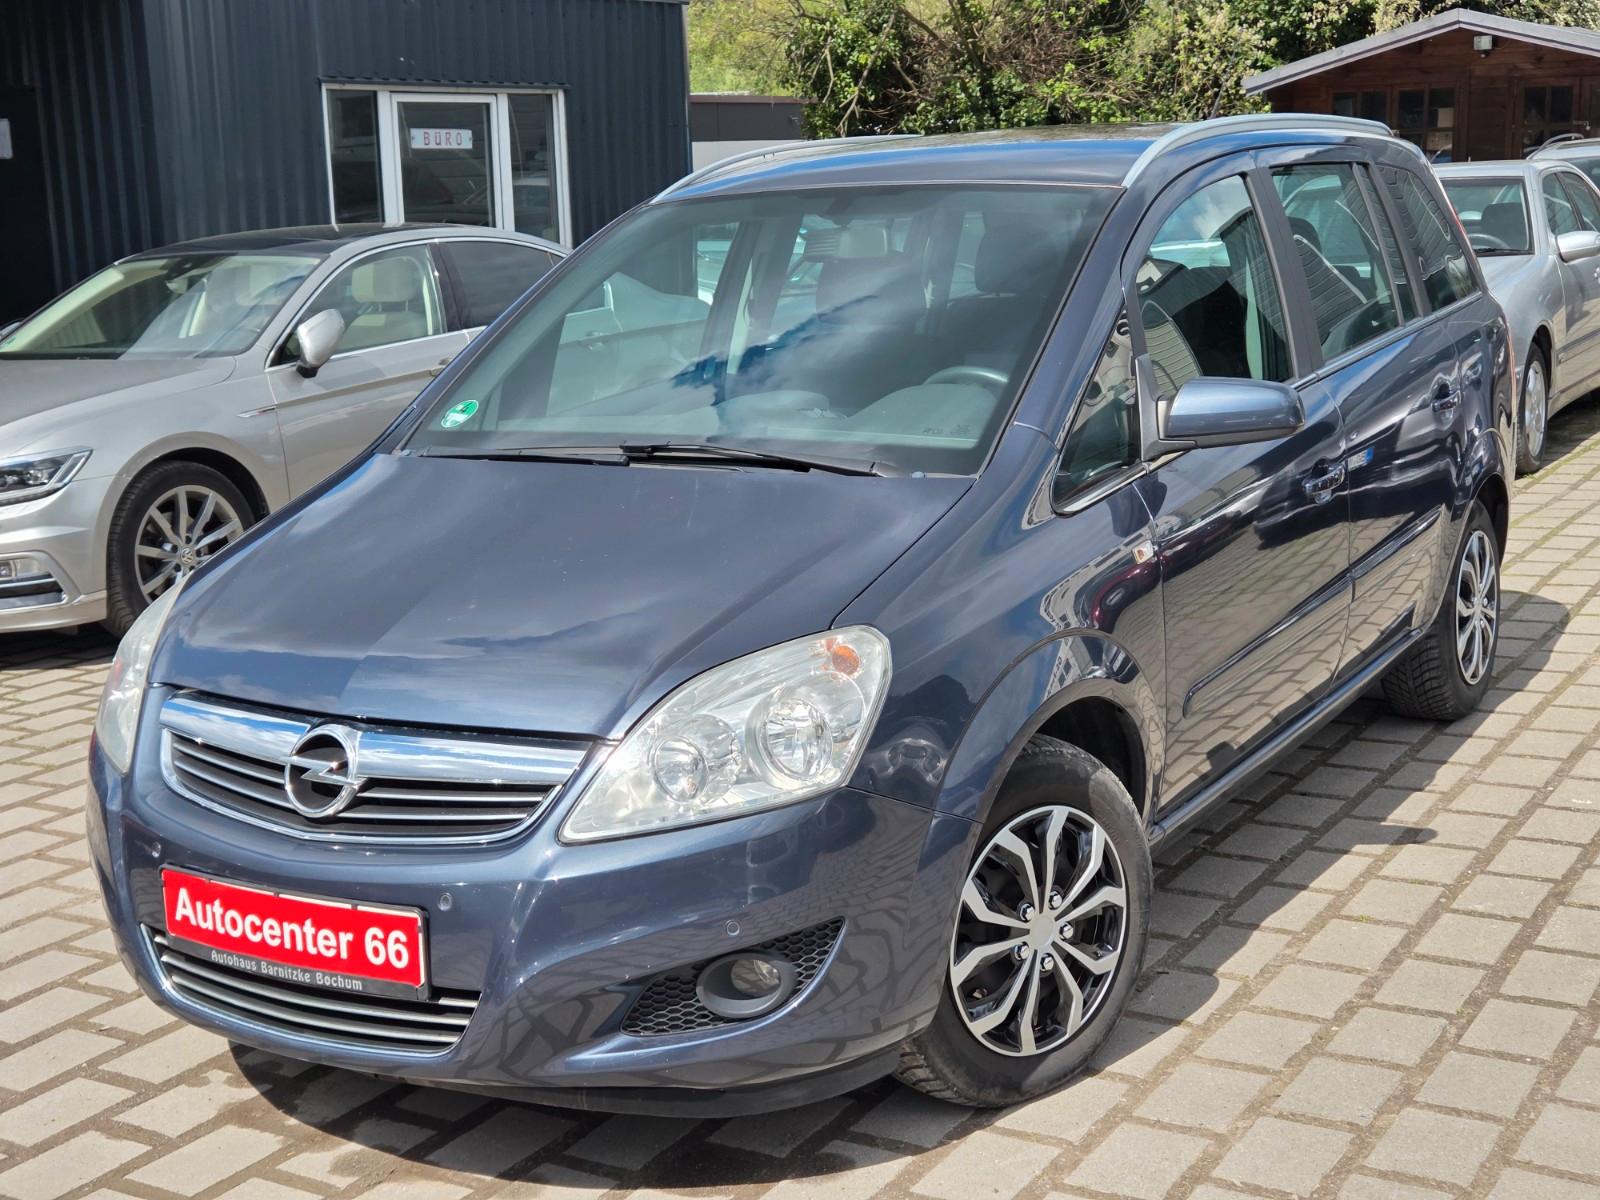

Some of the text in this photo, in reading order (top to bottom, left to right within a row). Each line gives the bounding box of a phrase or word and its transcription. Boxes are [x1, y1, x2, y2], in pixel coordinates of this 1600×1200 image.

[423, 131, 462, 146] BÜRO
[175, 887, 409, 969] Autocenter 66
[211, 950, 363, 991] Autohaus Barnitzke Bochum
